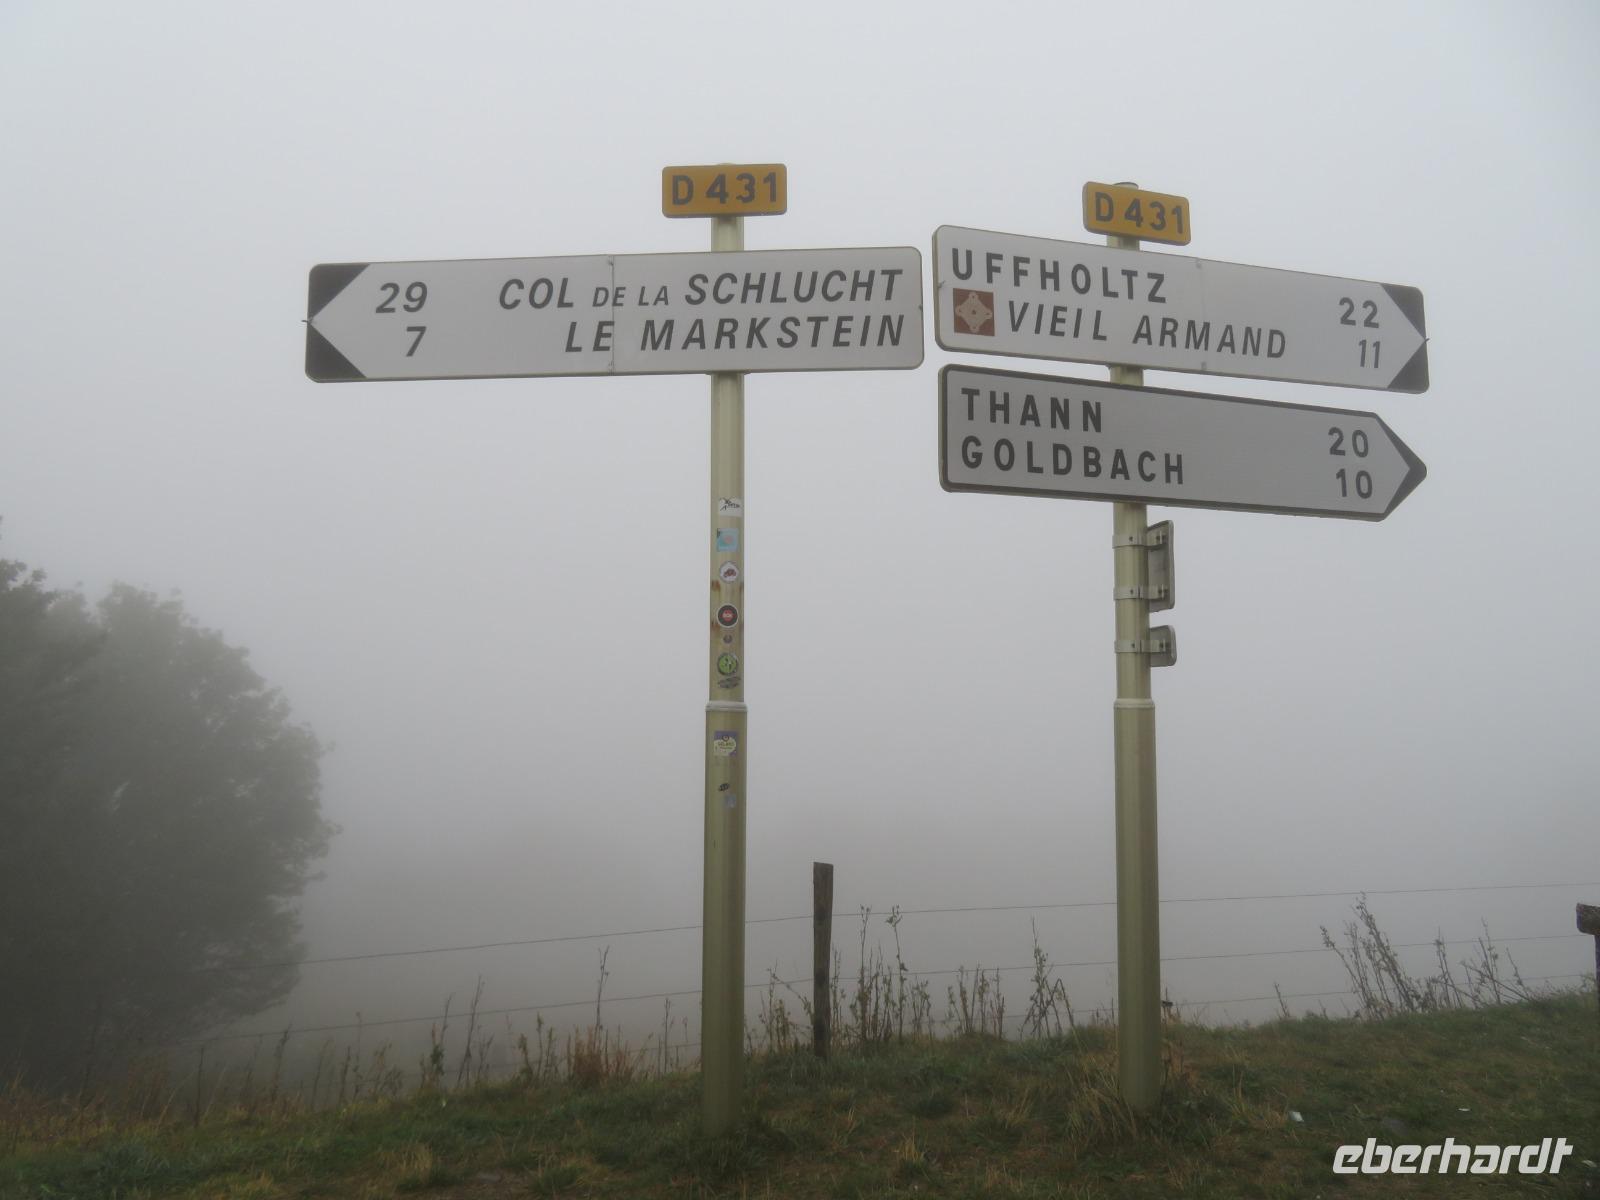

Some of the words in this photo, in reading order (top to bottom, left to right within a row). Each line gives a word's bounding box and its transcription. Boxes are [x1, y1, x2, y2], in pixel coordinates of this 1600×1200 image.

[672, 174, 694, 205] D
[705, 171, 778, 204] 431
[1096, 192, 1114, 222] D
[1124, 197, 1184, 235] 431
[376, 282, 428, 313] 29
[499, 278, 575, 311] COL
[593, 286, 627, 307] DE
[638, 286, 669, 306] LA
[685, 269, 904, 306] SCHLUCHT
[952, 248, 1166, 304] UFFHOLTZ
[1338, 296, 1380, 329] 22
[405, 326, 427, 357] 7
[565, 321, 615, 352] LE
[640, 315, 905, 351] MARKSTEIN
[1009, 300, 1108, 341] VIEIL
[1133, 315, 1286, 359] ARMAND
[1357, 339, 1381, 369] 11
[961, 387, 1102, 433] THANN
[1327, 426, 1369, 458] 20
[961, 435, 1184, 485] GOLDBACH
[1335, 468, 1373, 500] 10
